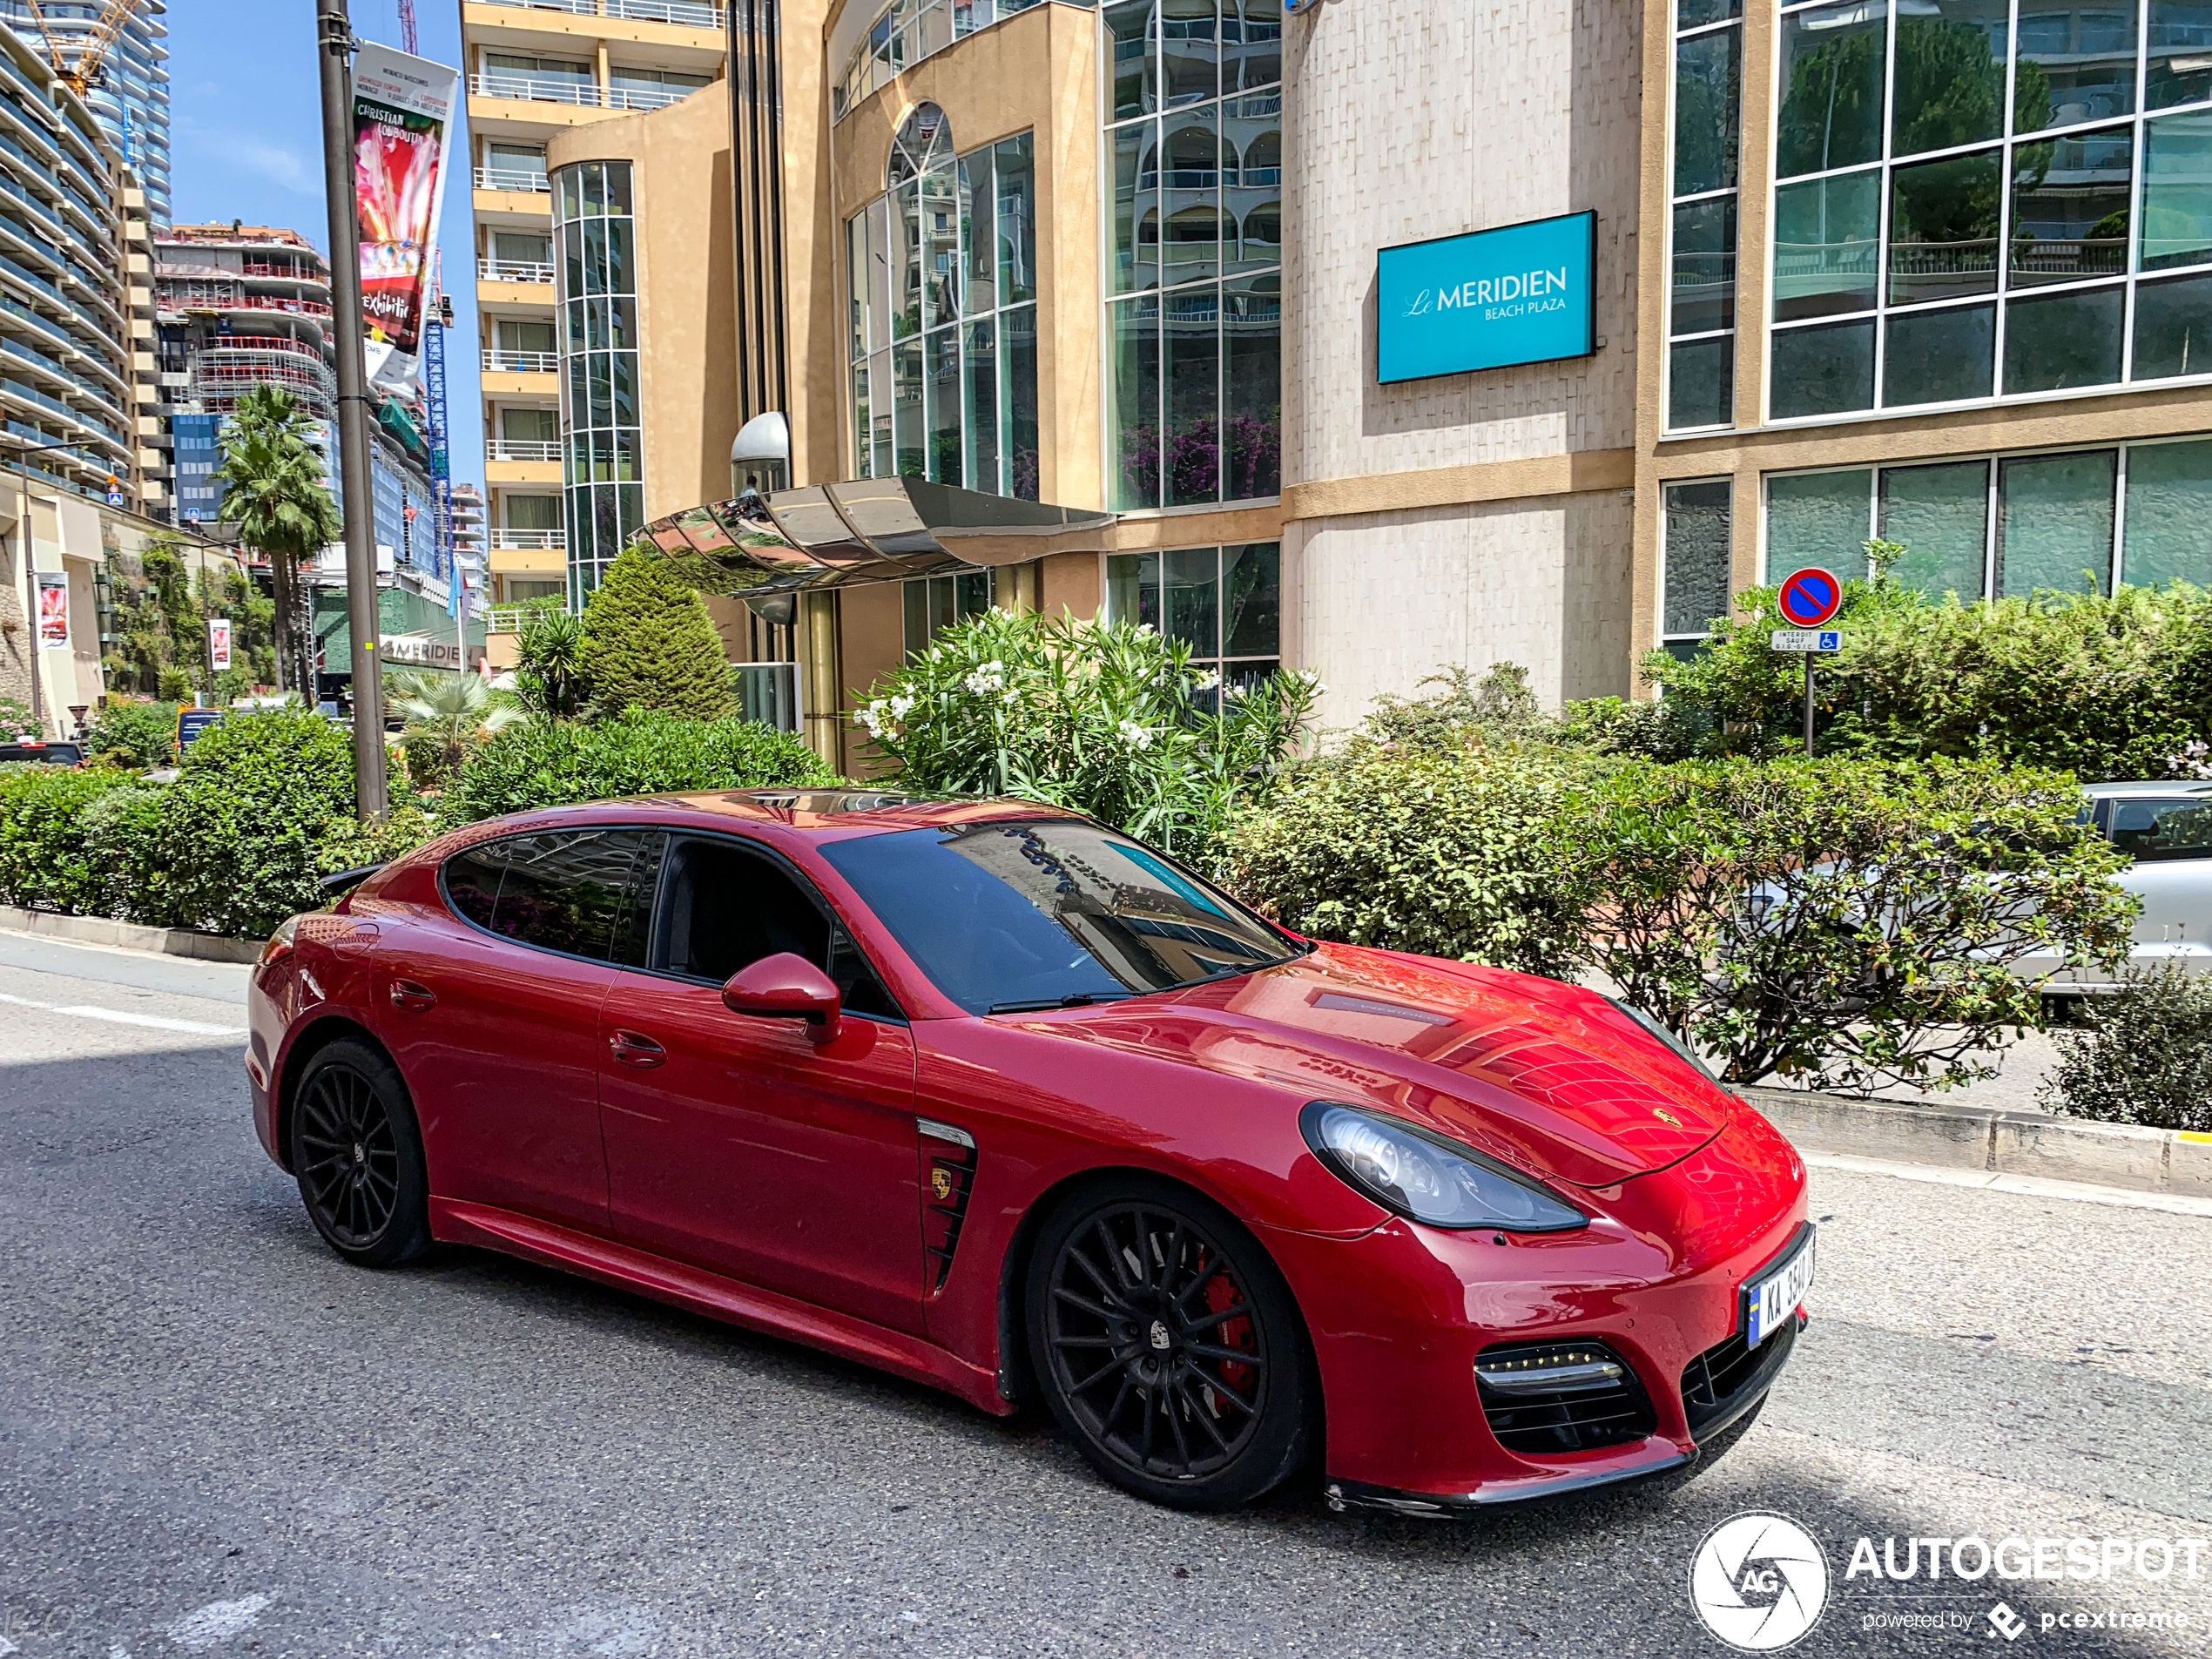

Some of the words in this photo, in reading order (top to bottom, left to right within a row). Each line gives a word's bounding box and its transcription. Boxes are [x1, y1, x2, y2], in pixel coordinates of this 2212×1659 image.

[357, 83, 378, 95] MONACO
[357, 104, 405, 126] CHRISTIAN
[1401, 288, 1433, 317] Le
[1437, 266, 1566, 311] MERIDIEN
[1485, 304, 1524, 320] BEACH
[1528, 297, 1566, 314] PLAZA
[1767, 1281, 1781, 1325] KA
